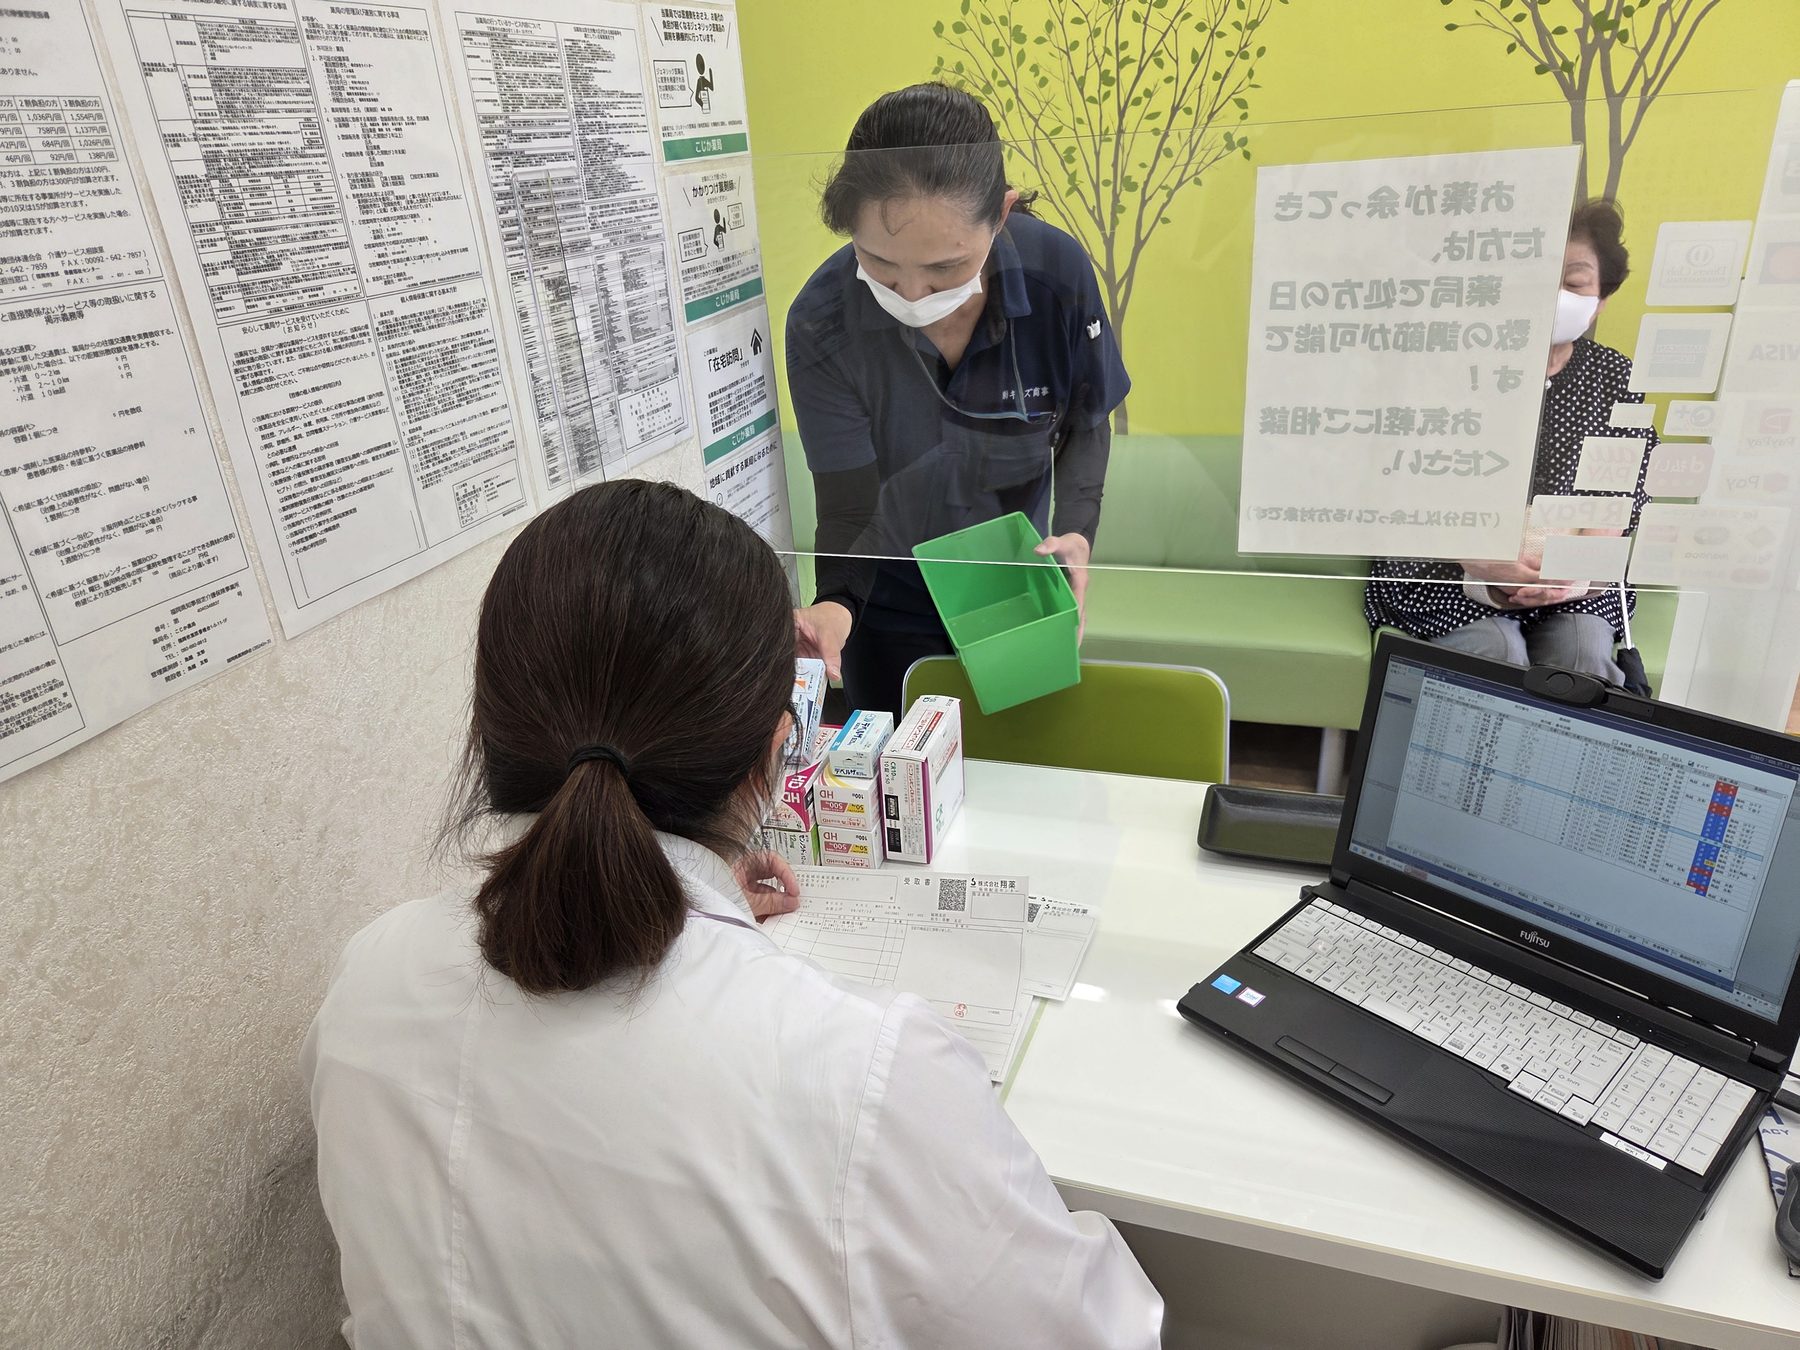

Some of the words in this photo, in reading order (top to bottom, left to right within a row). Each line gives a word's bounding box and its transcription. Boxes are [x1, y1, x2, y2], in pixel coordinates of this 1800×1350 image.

[695, 138, 722, 153] こじか薬局
[44, 312, 84, 324] 掲示義務等
[707, 347, 744, 372] 「在宅訪問」
[731, 424, 756, 446] こじか薬局
[788, 775, 806, 788] HD
[820, 790, 834, 799] HD
[824, 832, 838, 841] HD
[904, 877, 931, 886] 受取書
[1520, 930, 1550, 948] FUJITSU
